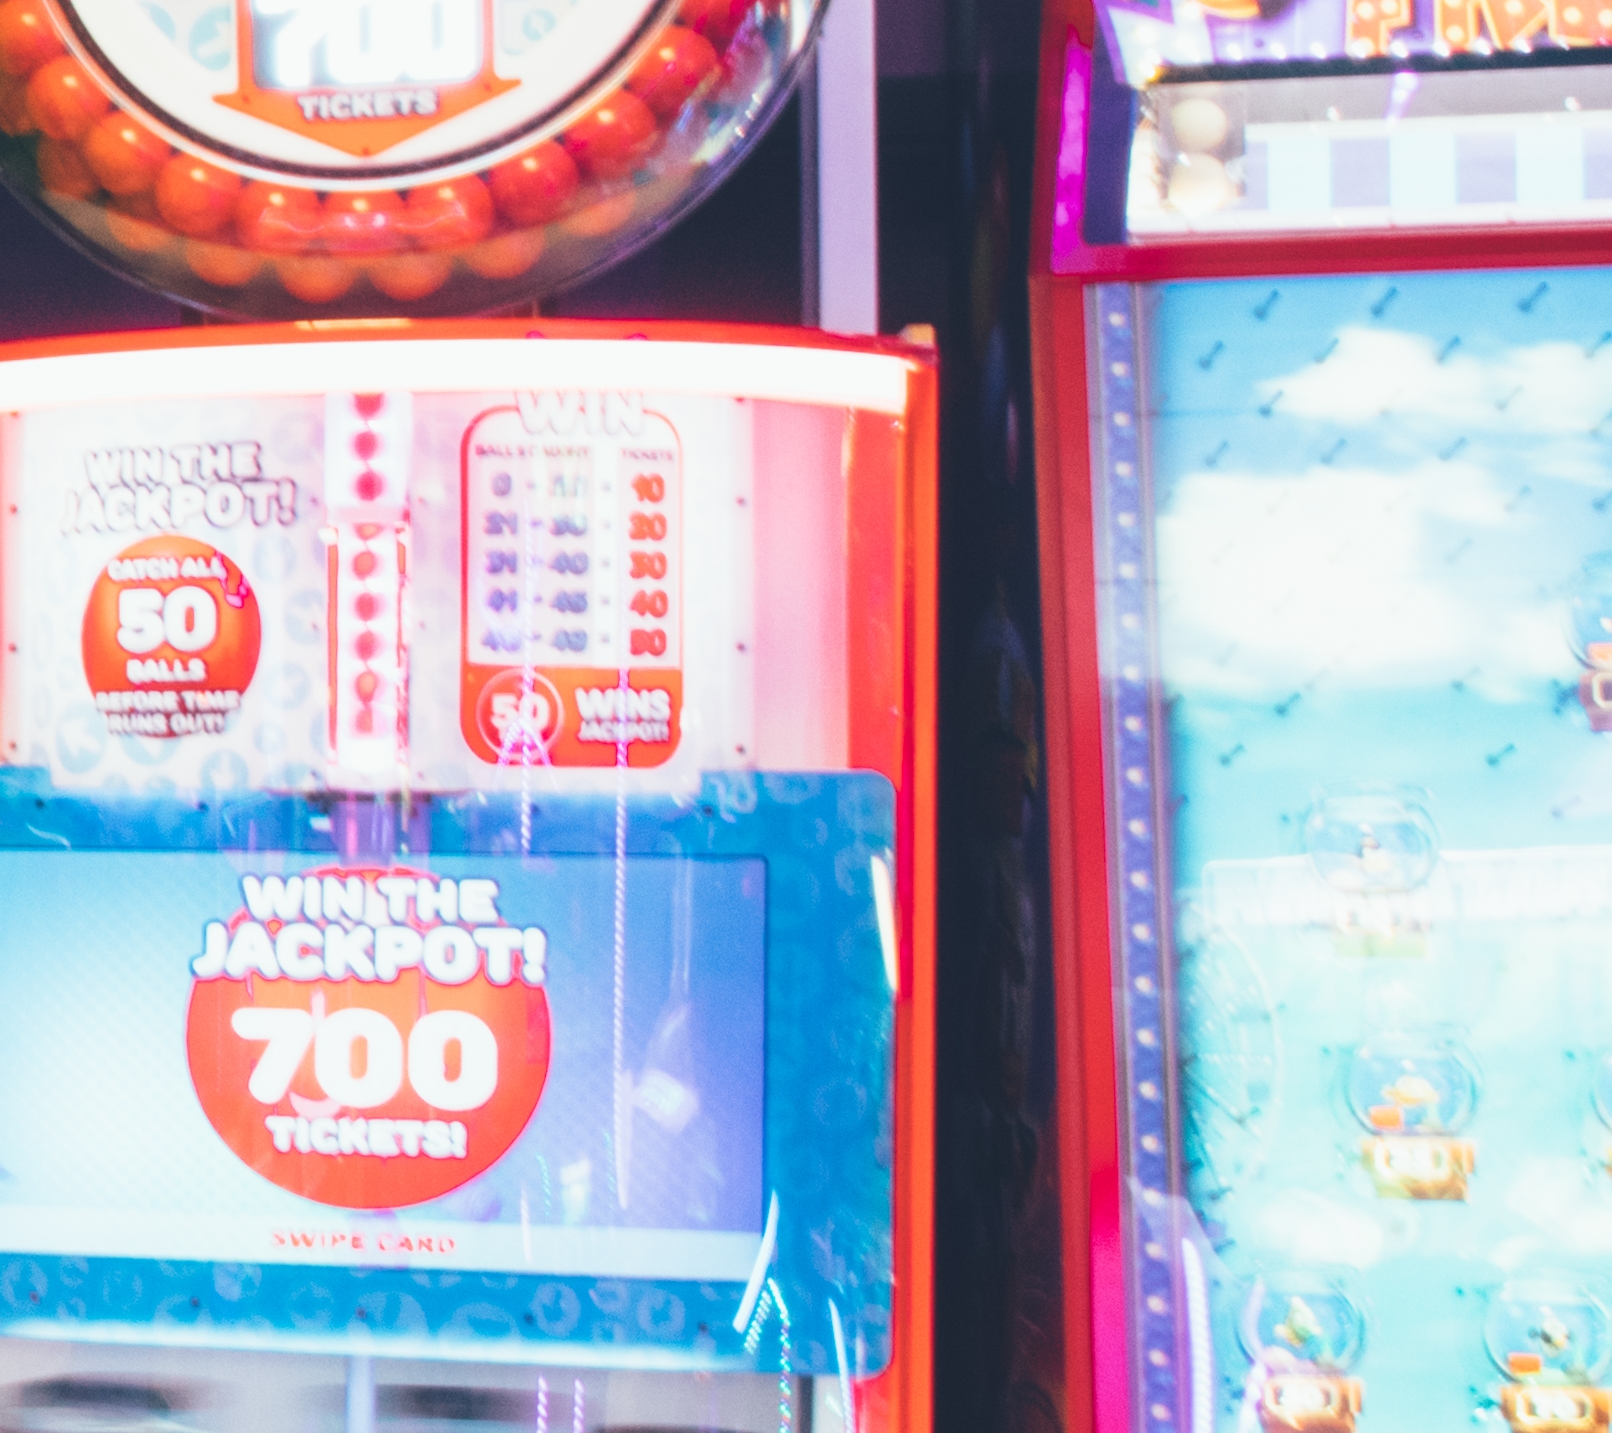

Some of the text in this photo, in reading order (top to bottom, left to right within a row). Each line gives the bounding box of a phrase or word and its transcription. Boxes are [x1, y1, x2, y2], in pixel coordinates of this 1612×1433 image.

[297, 88, 439, 122] TICKETS
[85, 440, 263, 488] WIN THE
[60, 478, 298, 535] JACKPOT!
[116, 585, 218, 654] 50
[126, 658, 208, 684] BALLS
[574, 687, 671, 723] WINS
[241, 873, 501, 925] WIN THE
[190, 920, 548, 988] JACKPOT!
[231, 1006, 499, 1112] 700
[264, 1114, 469, 1160] TICKETS!
